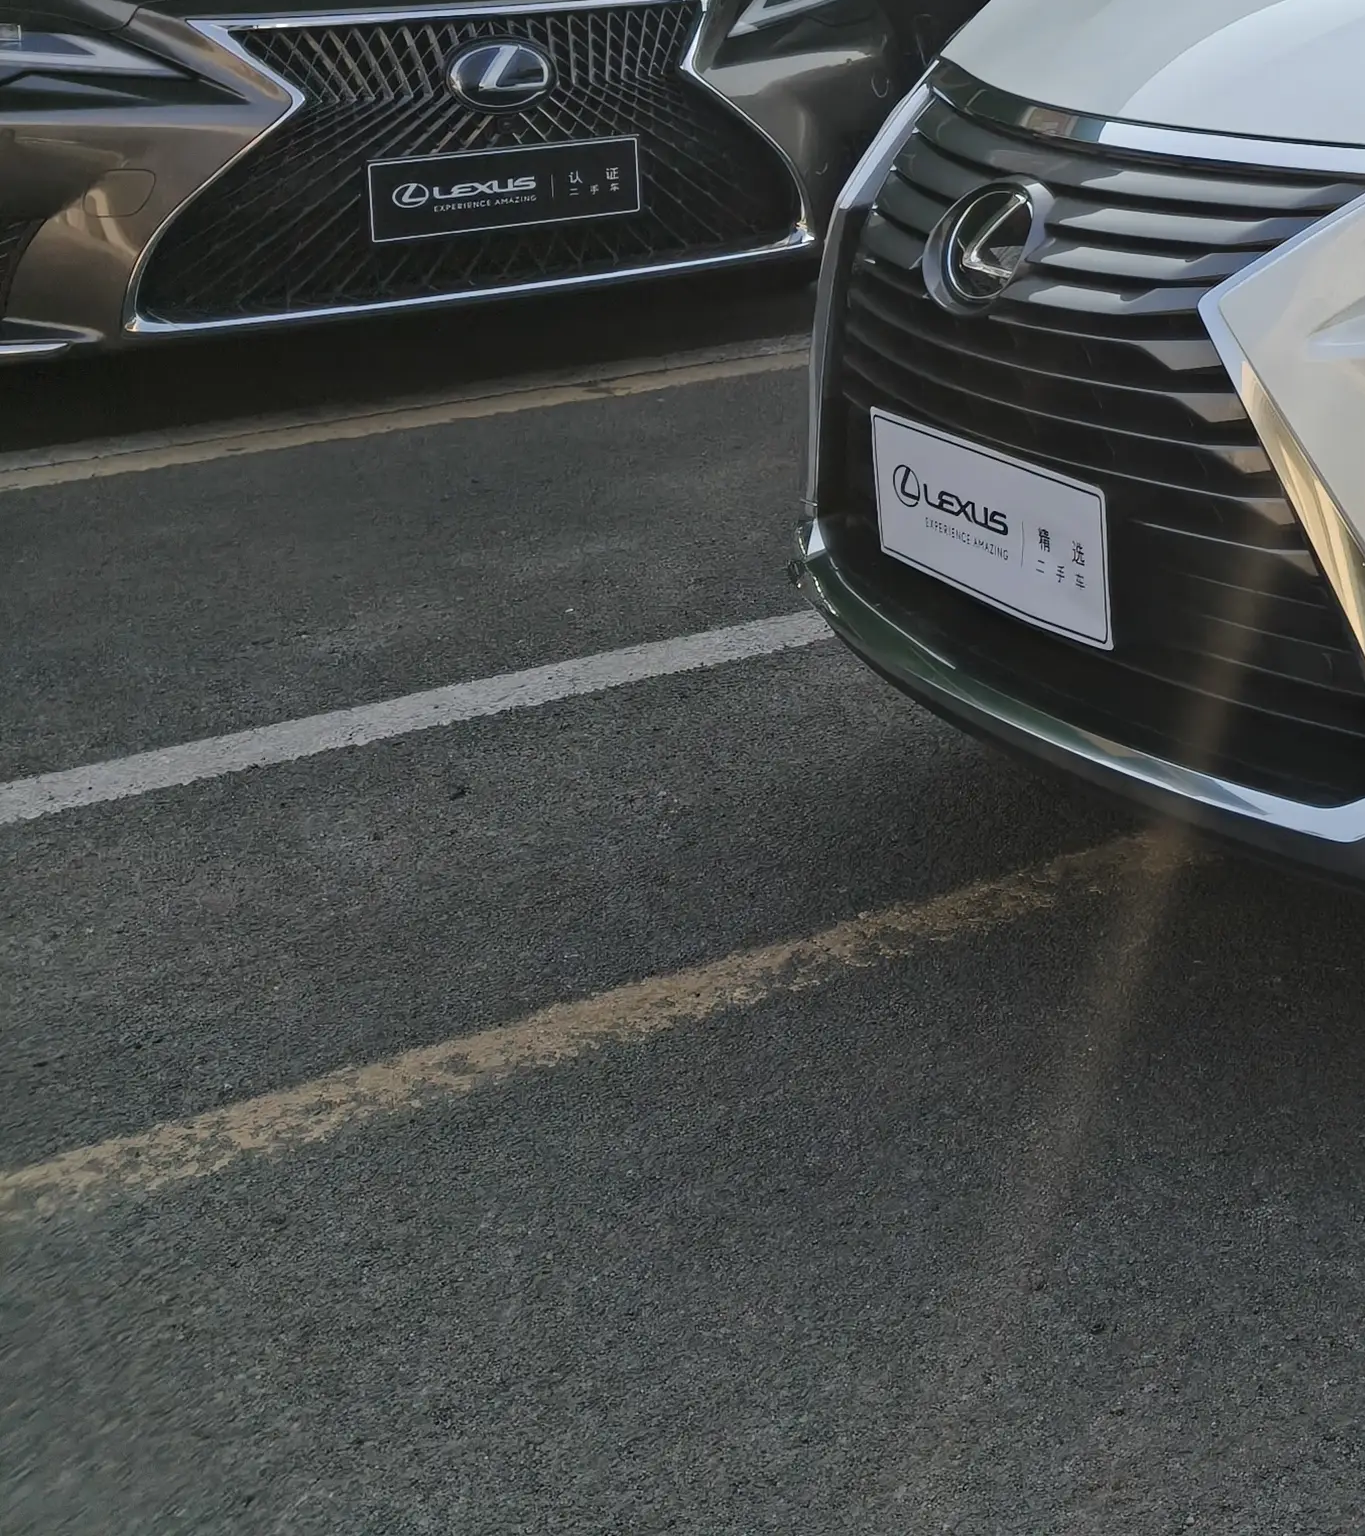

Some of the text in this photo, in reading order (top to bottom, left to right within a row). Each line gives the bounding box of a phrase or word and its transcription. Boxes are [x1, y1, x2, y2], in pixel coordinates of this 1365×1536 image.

[432, 176, 537, 199] LEXUS
[434, 194, 537, 212] EXPERIENCE AMAZING
[923, 483, 1008, 535] LEXUS
[925, 517, 1009, 561] EXPERIENCE AMAZING
